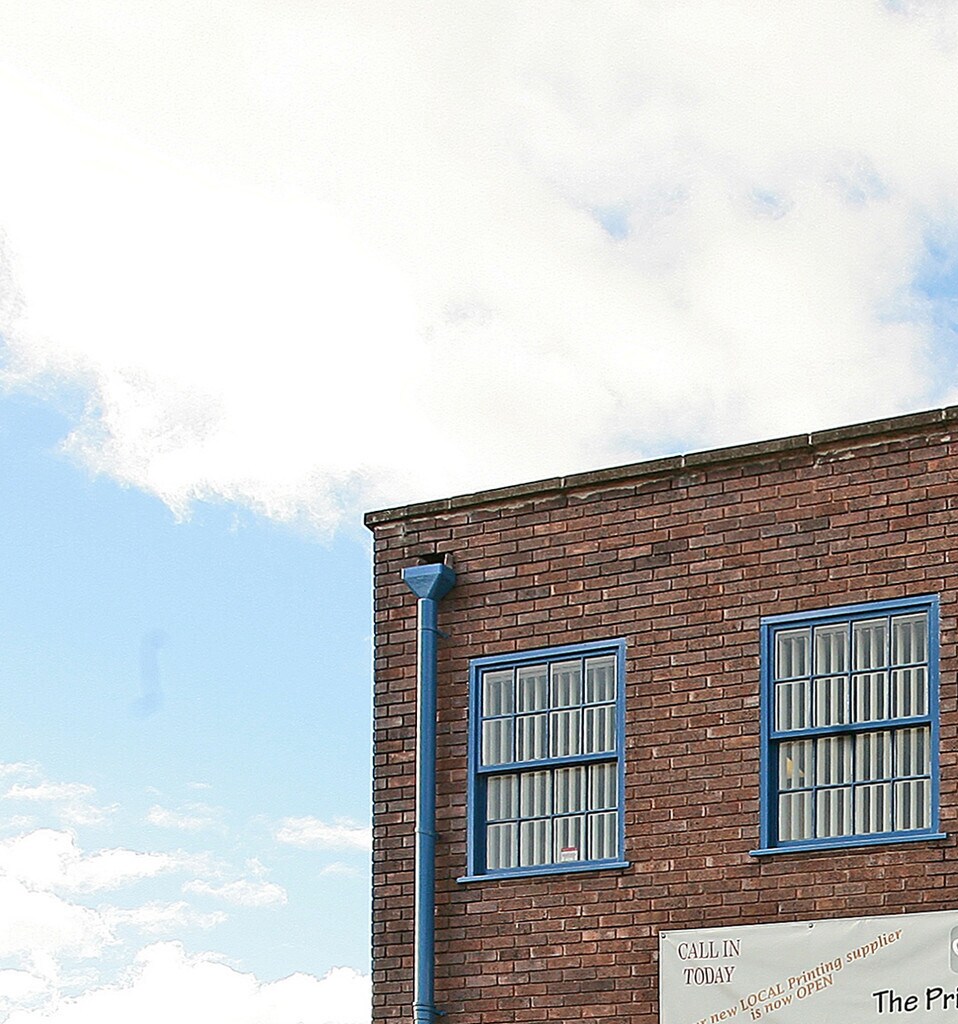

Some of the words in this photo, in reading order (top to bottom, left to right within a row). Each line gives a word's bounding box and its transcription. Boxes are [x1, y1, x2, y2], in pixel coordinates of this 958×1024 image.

[678, 941, 719, 960] CALL
[723, 939, 741, 957] IN
[684, 966, 735, 985] TODAY
[710, 1006, 738, 1024] new
[740, 983, 785, 1012] LOCAL
[788, 957, 842, 989] Printing
[846, 929, 903, 963] supplier
[750, 1007, 762, 1021] is
[764, 994, 792, 1014] now
[797, 974, 835, 999] OPEN
[872, 989, 919, 1013] The
